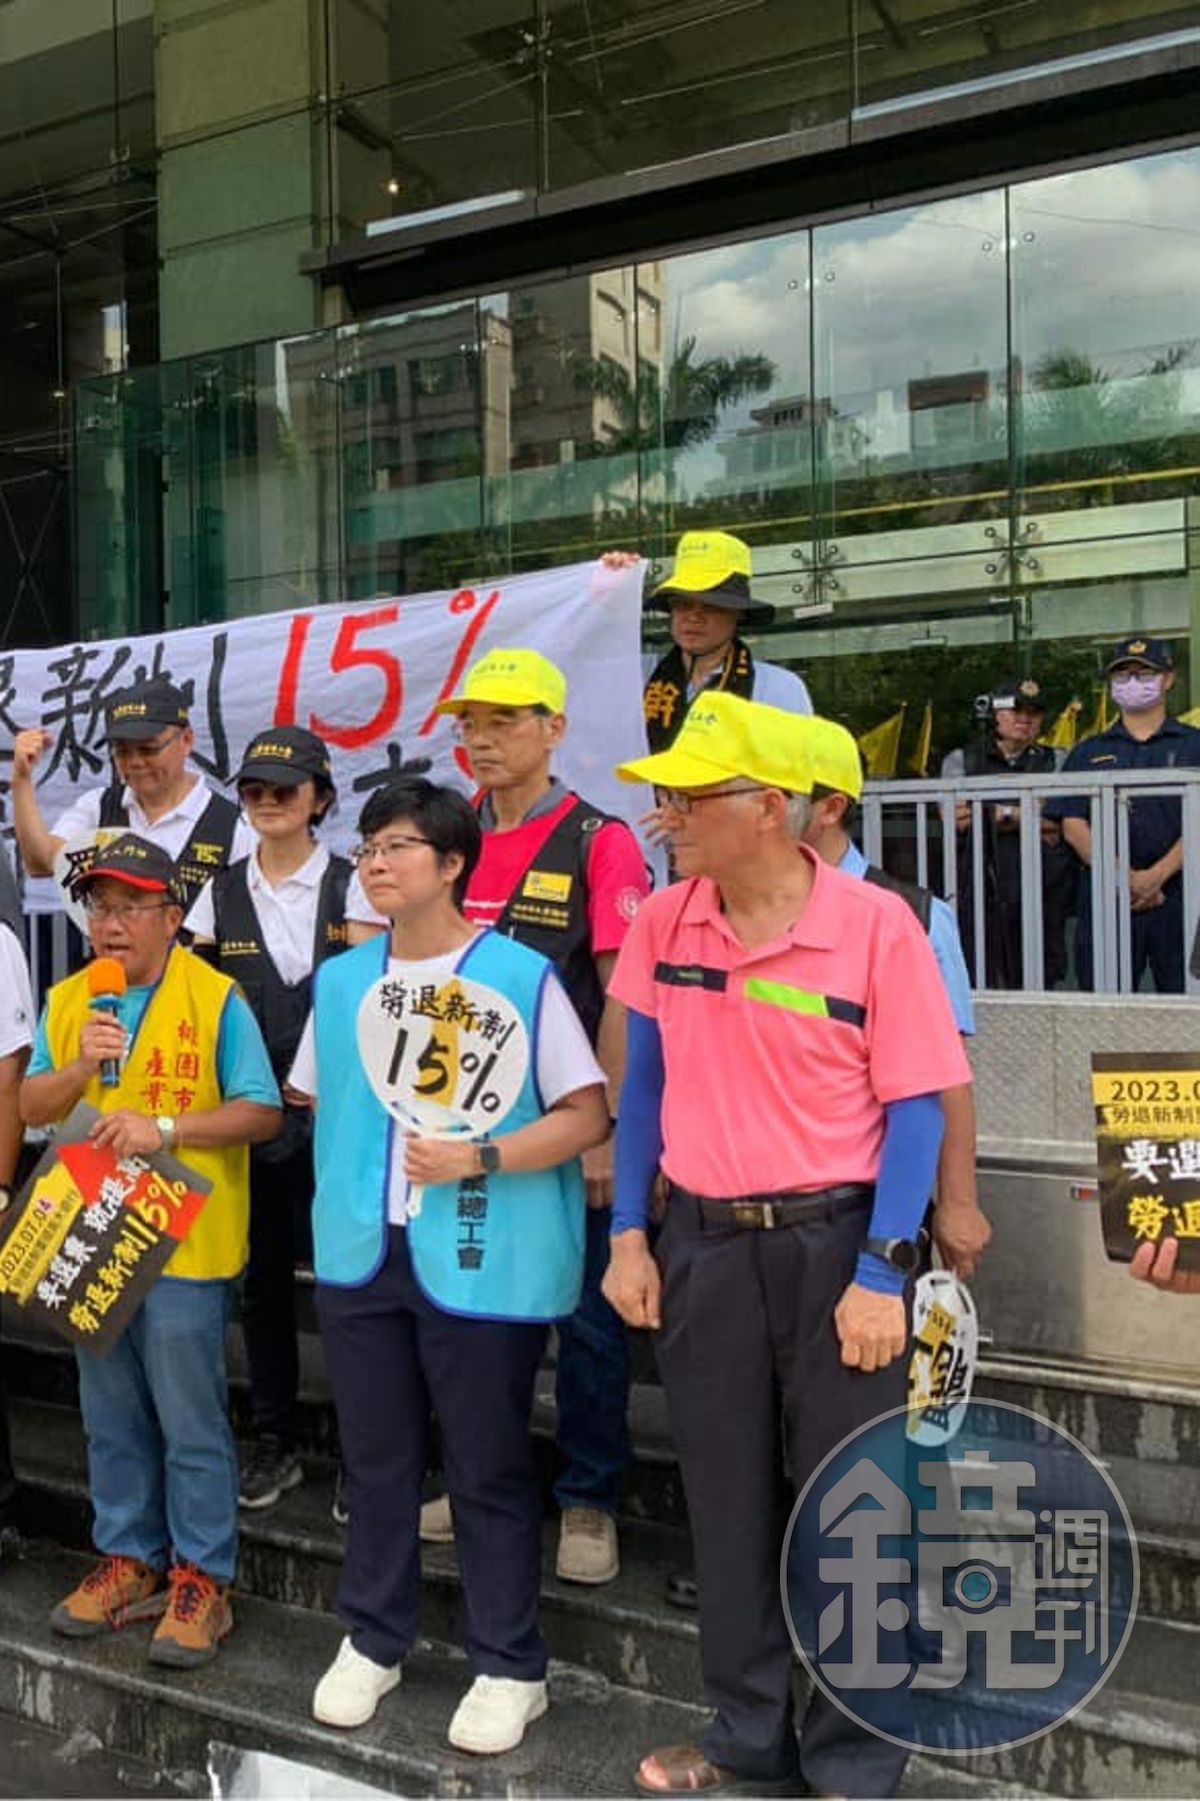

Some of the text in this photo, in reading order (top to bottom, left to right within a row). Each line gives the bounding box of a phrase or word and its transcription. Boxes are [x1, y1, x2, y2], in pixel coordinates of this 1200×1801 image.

[273, 588, 500, 750] 15%
[380, 979, 518, 1051] 勞退新制
[172, 1018, 199, 1115] 桃園市
[386, 1028, 501, 1113] 15%
[1112, 1105, 1200, 1126] 勞退新制
